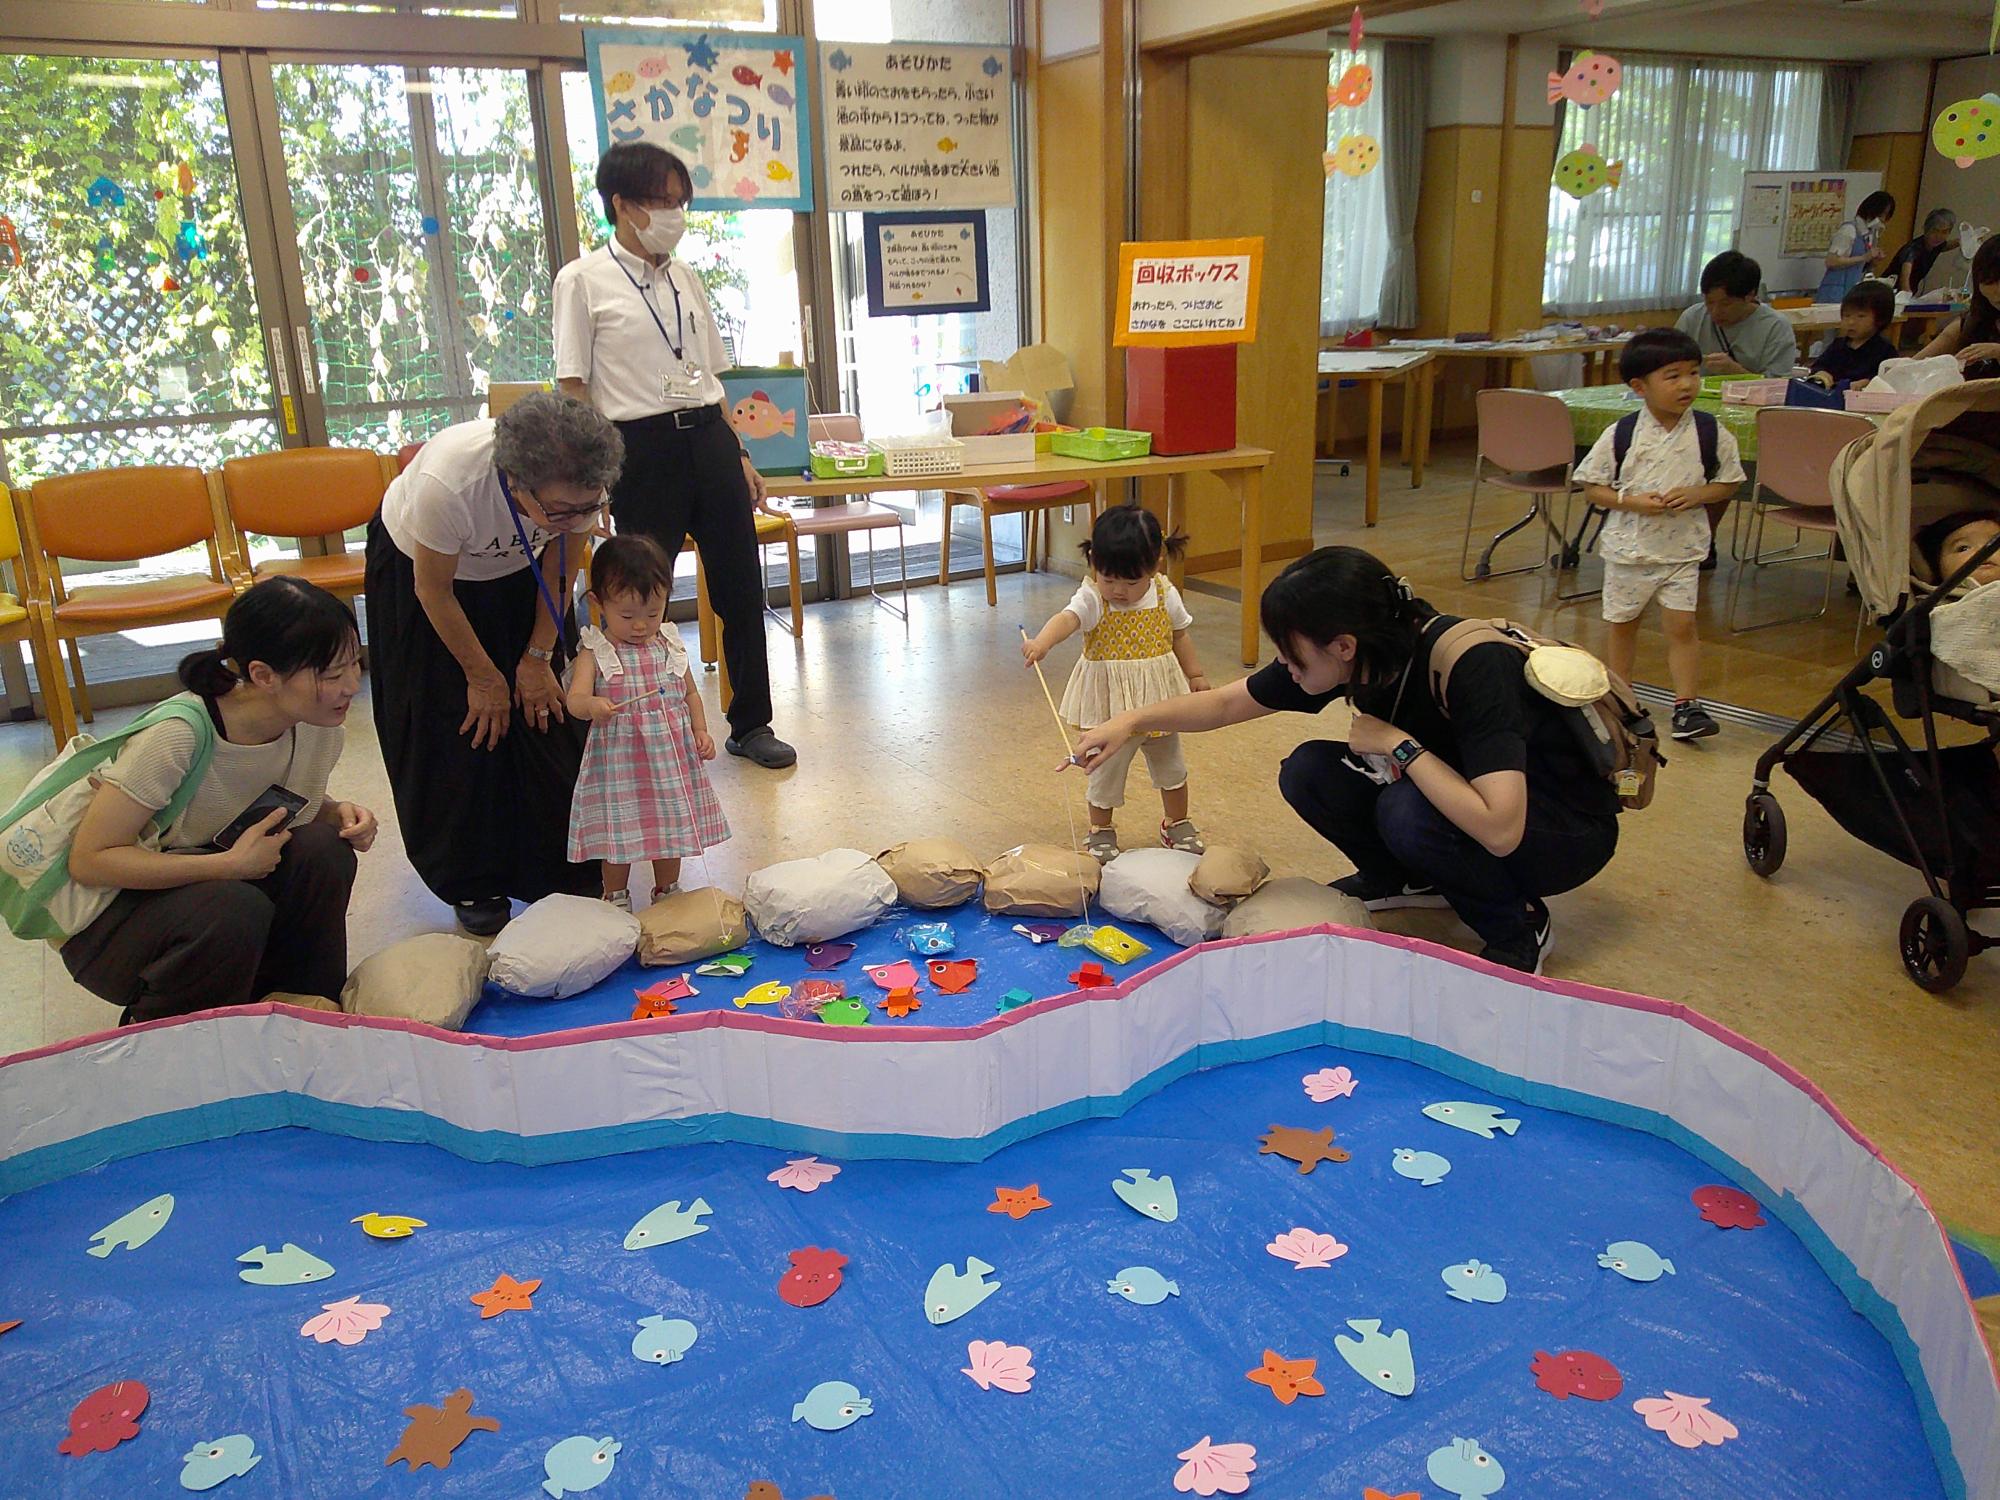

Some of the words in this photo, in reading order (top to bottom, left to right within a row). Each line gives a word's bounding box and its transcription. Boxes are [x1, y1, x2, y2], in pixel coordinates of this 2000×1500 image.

[885, 54, 952, 72] あそびかた
[607, 72, 782, 151] さかなつり
[910, 229, 945, 239] あそびかた
[1137, 263, 1239, 285] 回収ボックス
